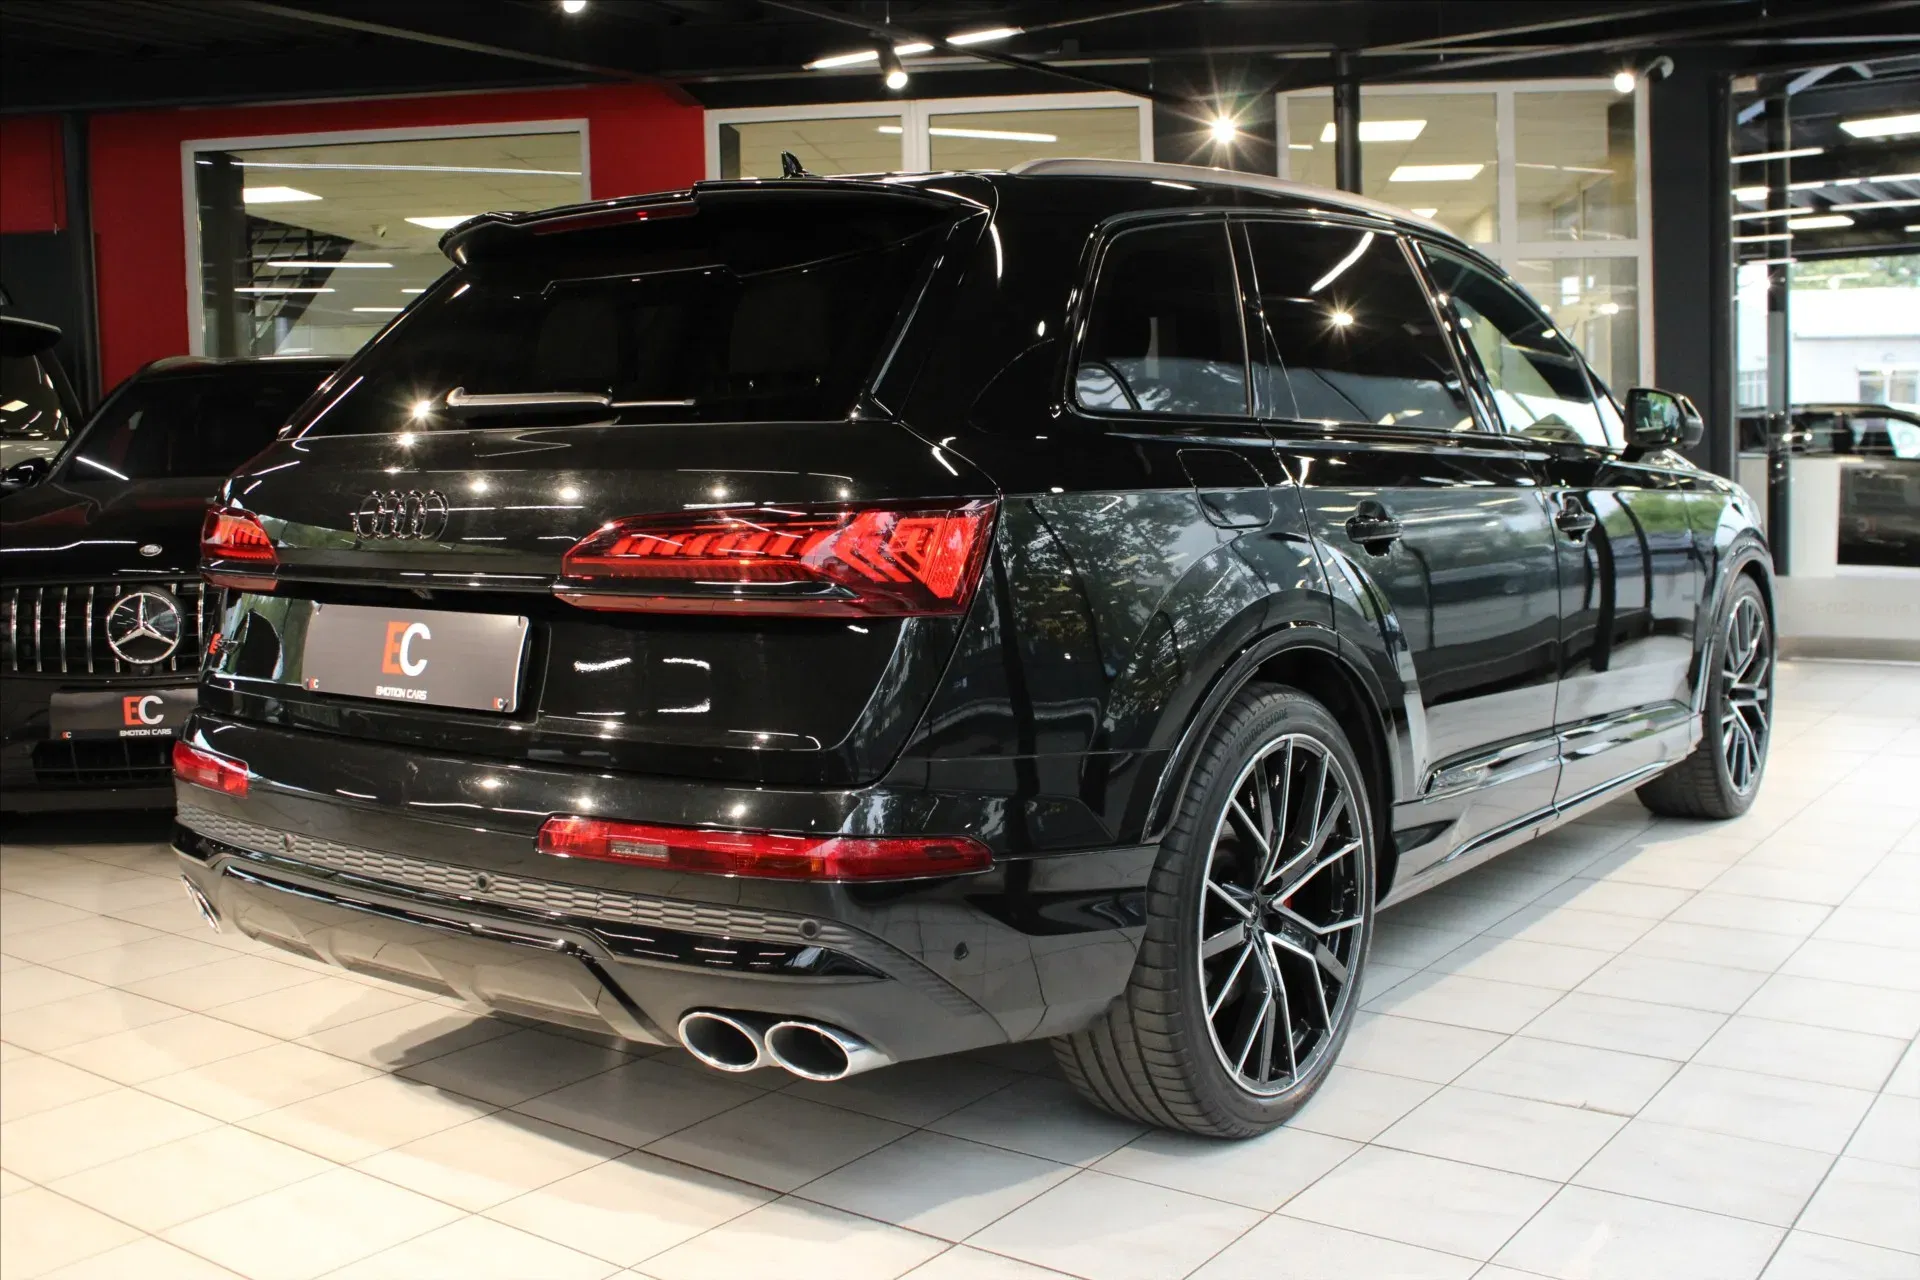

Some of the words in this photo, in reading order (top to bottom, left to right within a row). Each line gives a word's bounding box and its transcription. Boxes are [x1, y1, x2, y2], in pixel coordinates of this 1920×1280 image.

[381, 620, 431, 676] EC
[375, 685, 406, 698] EMOTION
[406, 688, 428, 700] CARS
[123, 695, 164, 725] EC
[119, 729, 150, 737] EMOTION
[151, 728, 172, 736] CARS
